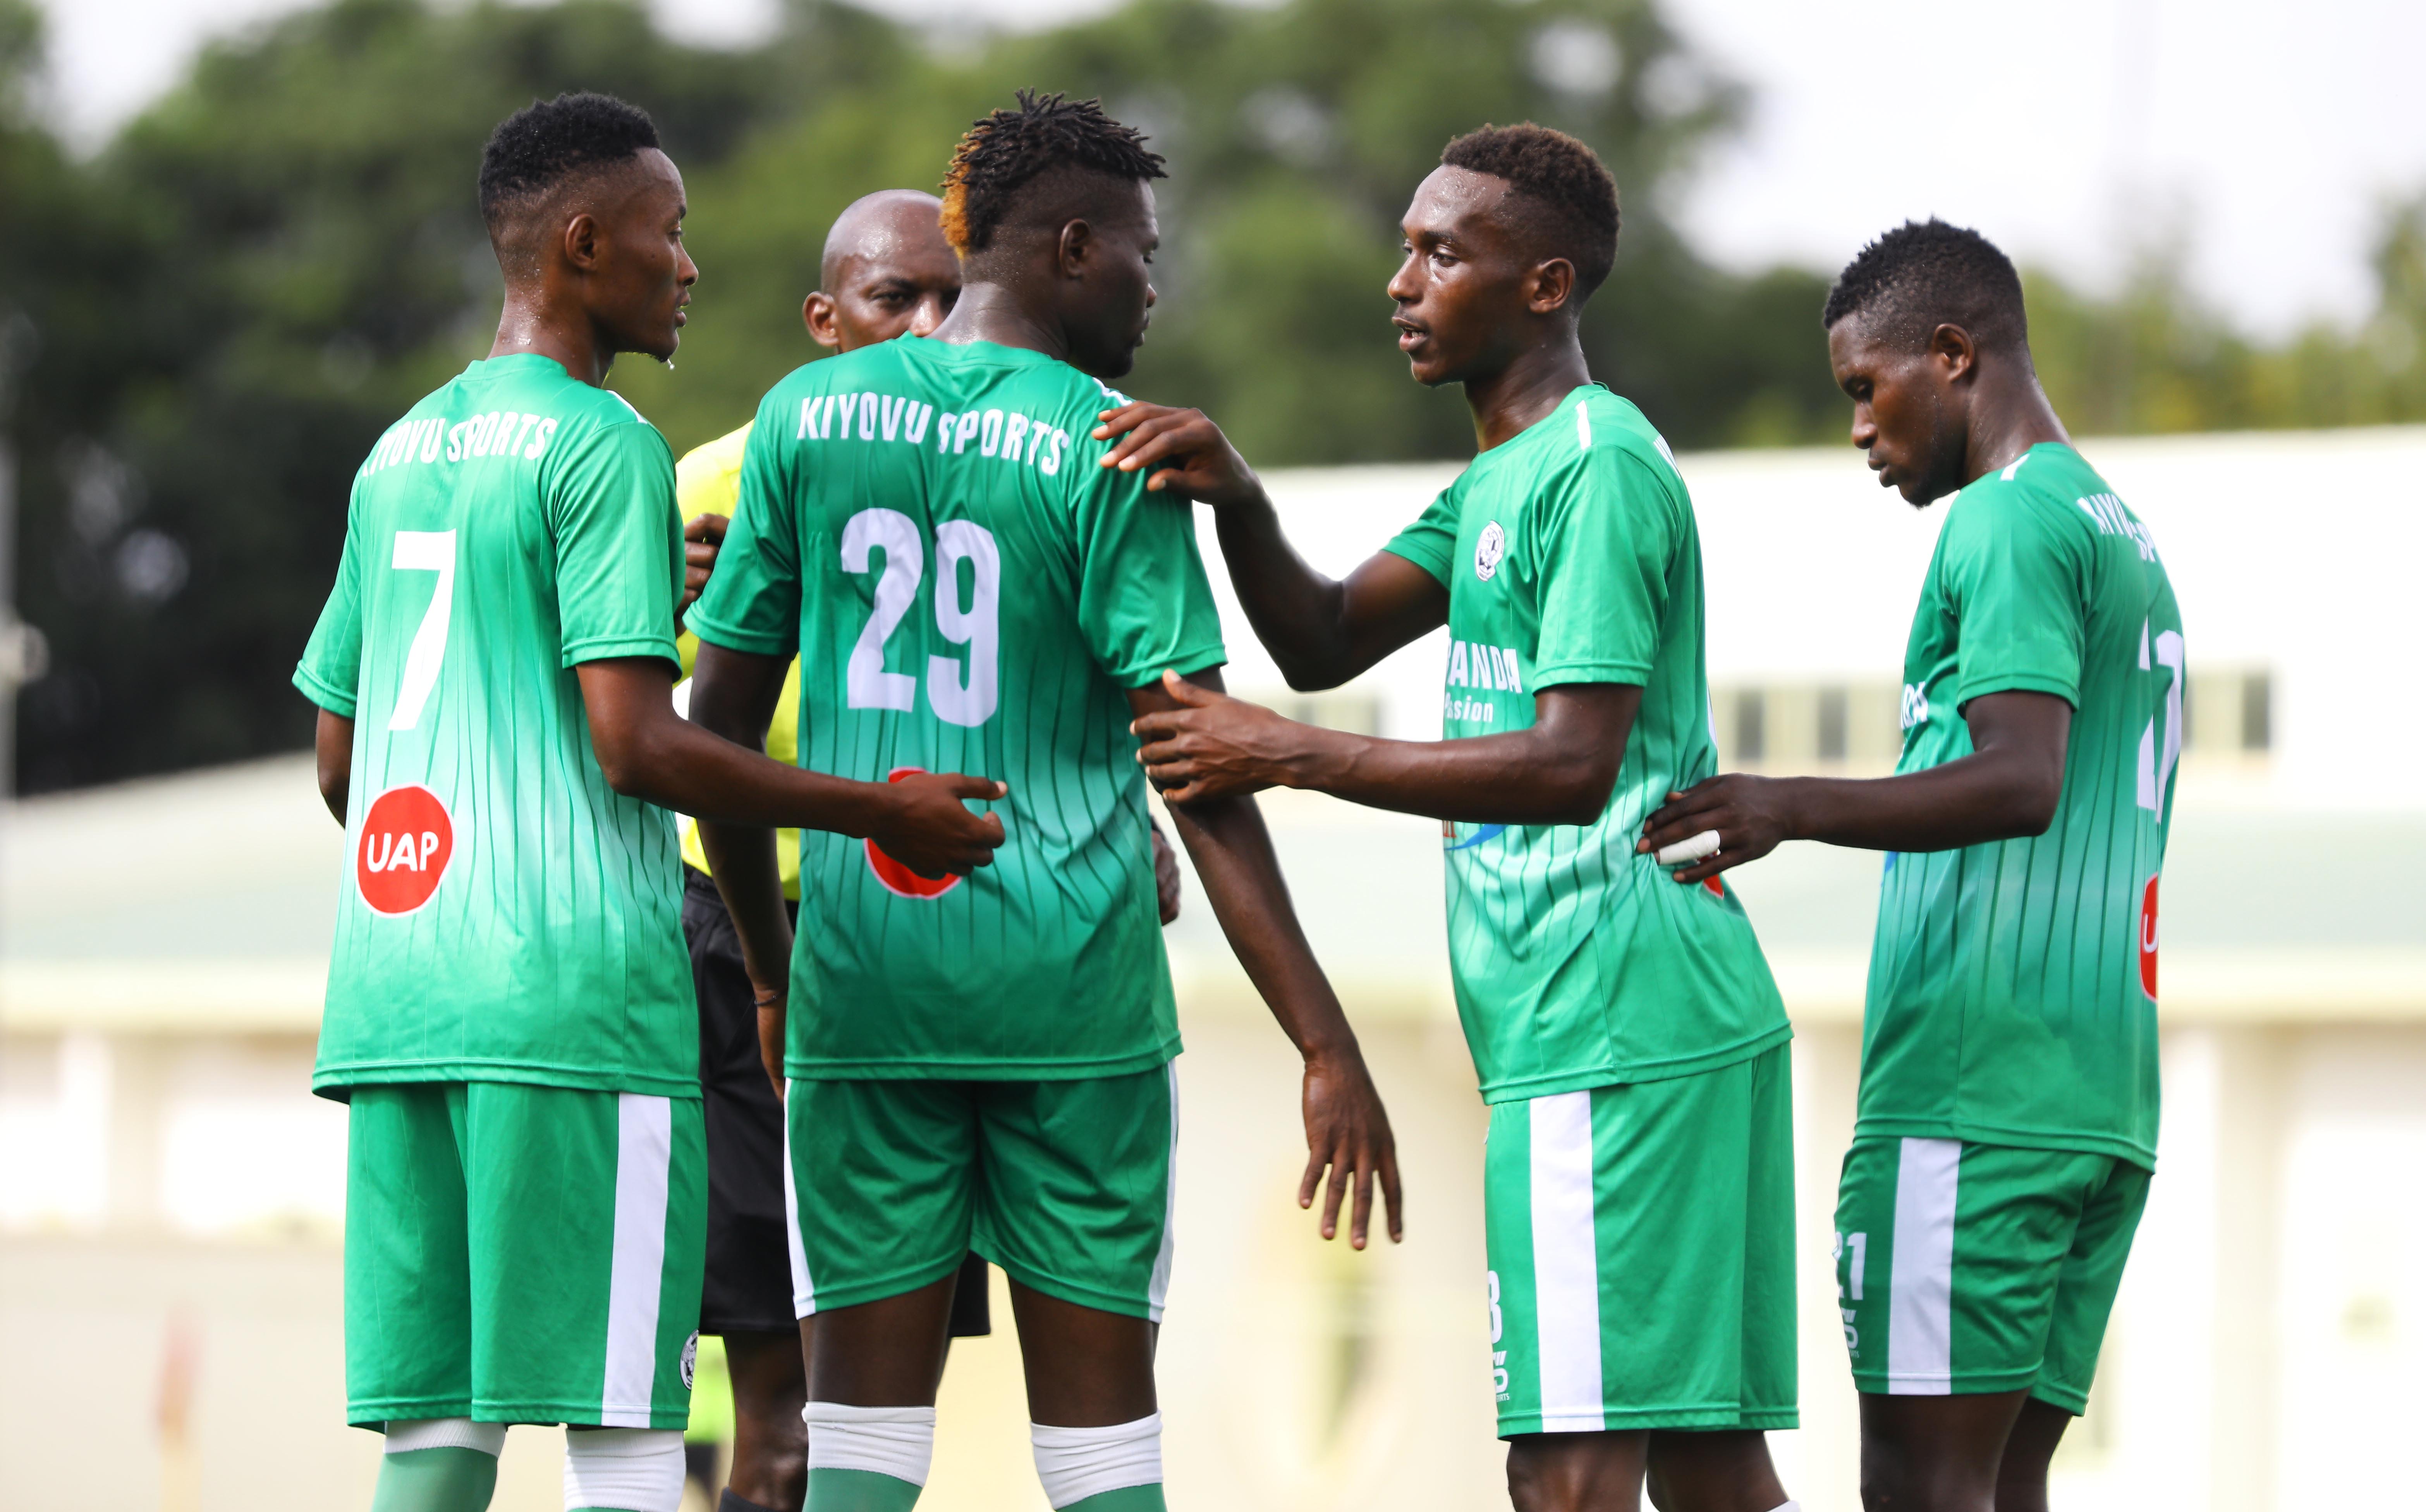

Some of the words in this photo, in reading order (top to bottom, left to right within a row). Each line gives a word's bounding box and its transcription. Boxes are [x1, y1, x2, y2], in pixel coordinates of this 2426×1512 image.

[447, 411, 558, 462] SPORTS
[797, 392, 933, 444] KIYOVU
[938, 409, 1070, 476] SPORTS
[389, 528, 457, 731] 7
[840, 507, 1000, 727] 29
[1446, 637, 1523, 694] ANDA
[367, 831, 439, 873] UAP
